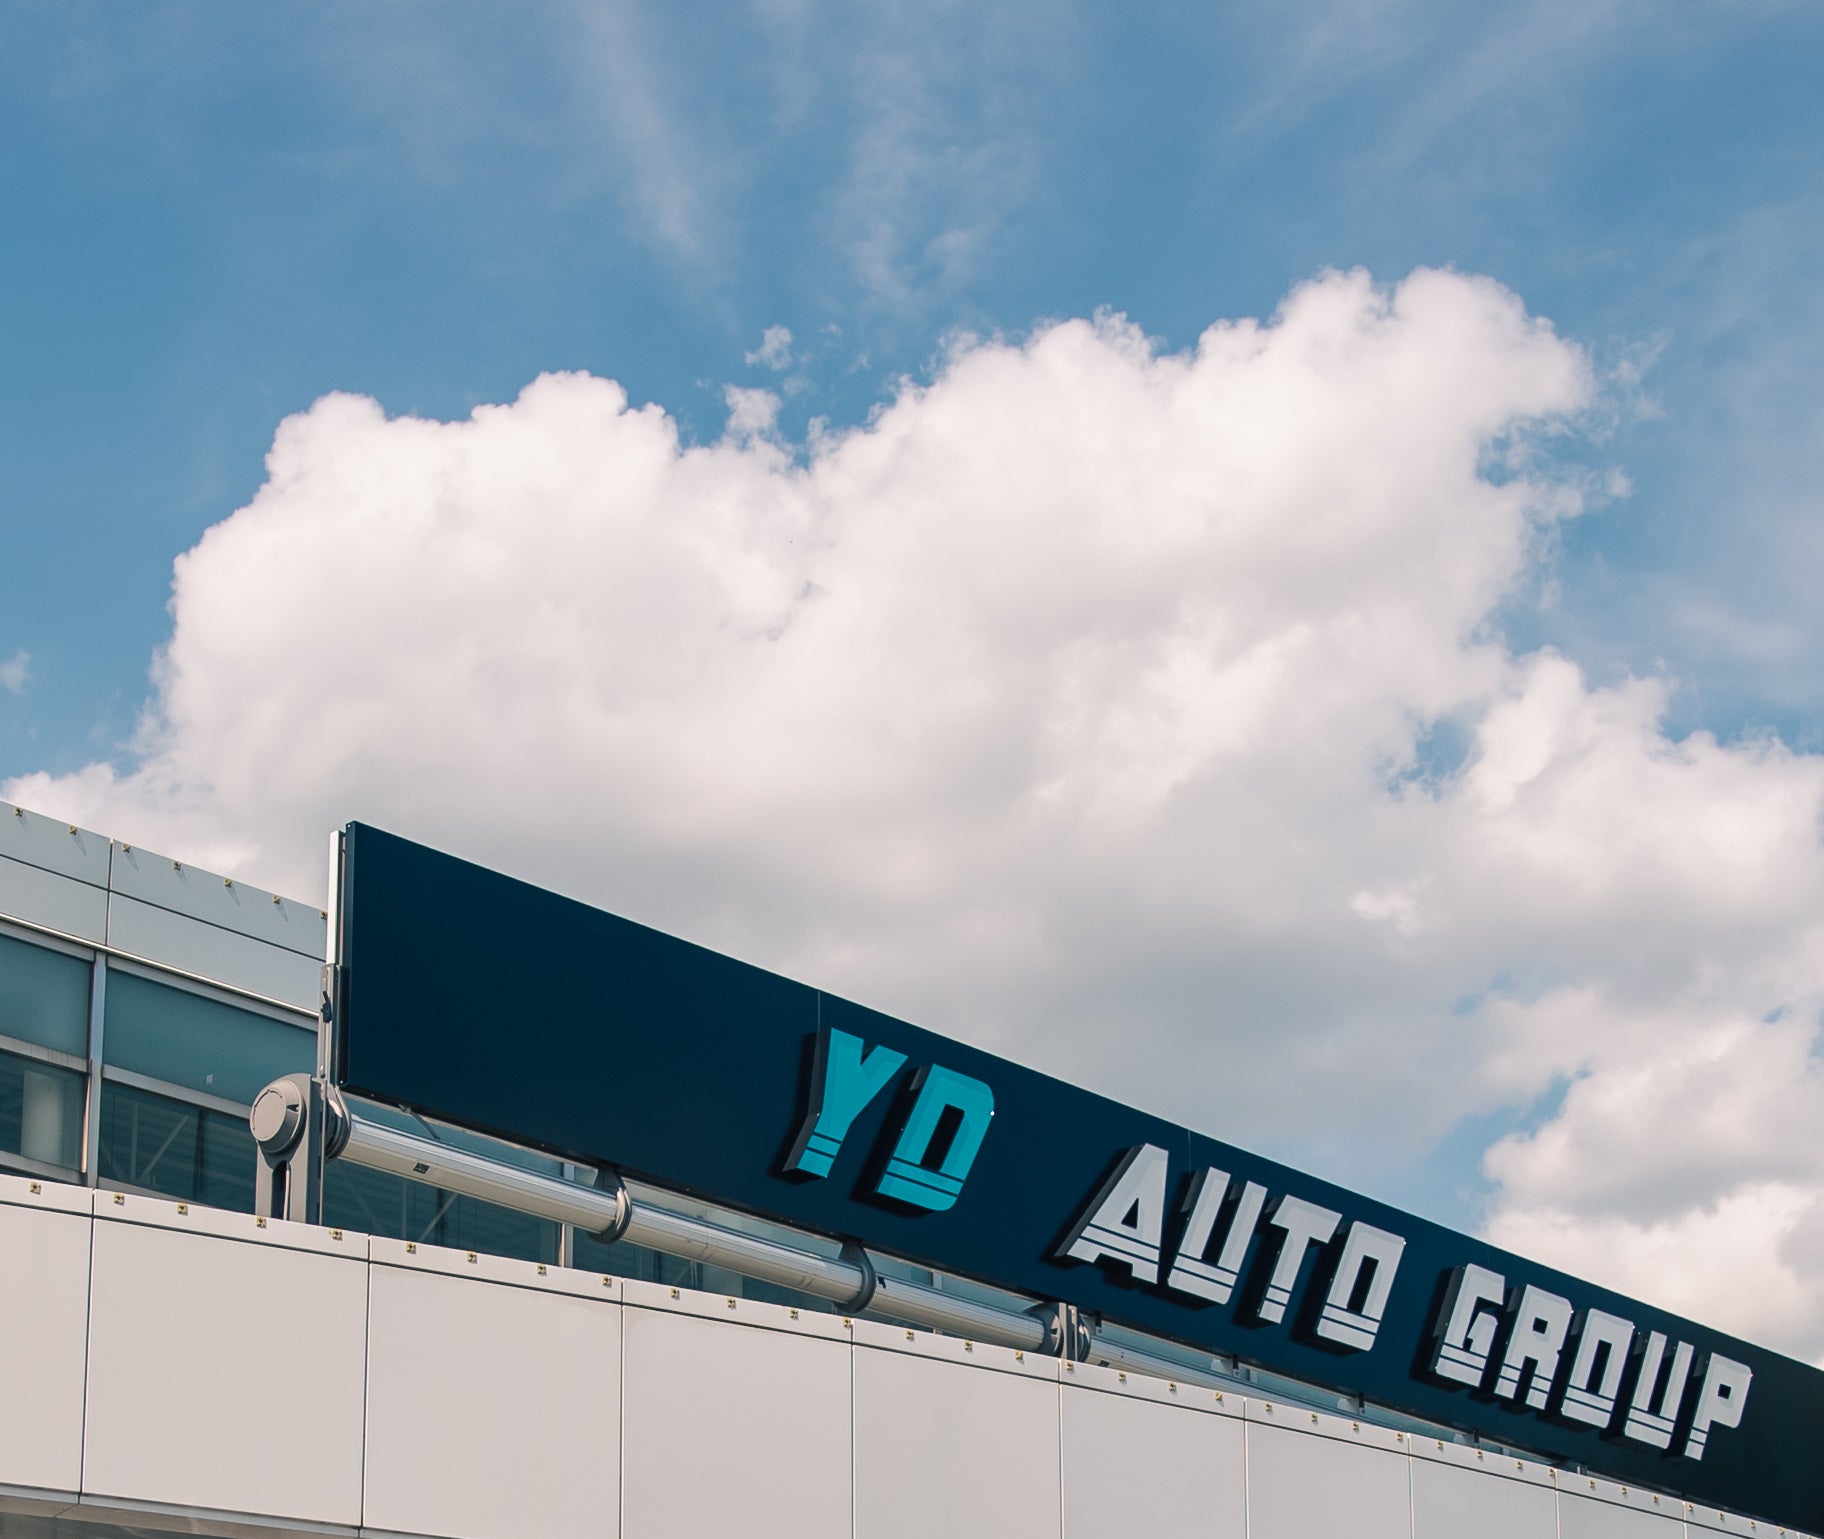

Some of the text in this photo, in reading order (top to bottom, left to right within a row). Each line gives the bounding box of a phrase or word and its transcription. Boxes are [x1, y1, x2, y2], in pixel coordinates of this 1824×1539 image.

[788, 1027, 1755, 1463] YD AUTO GROUP
